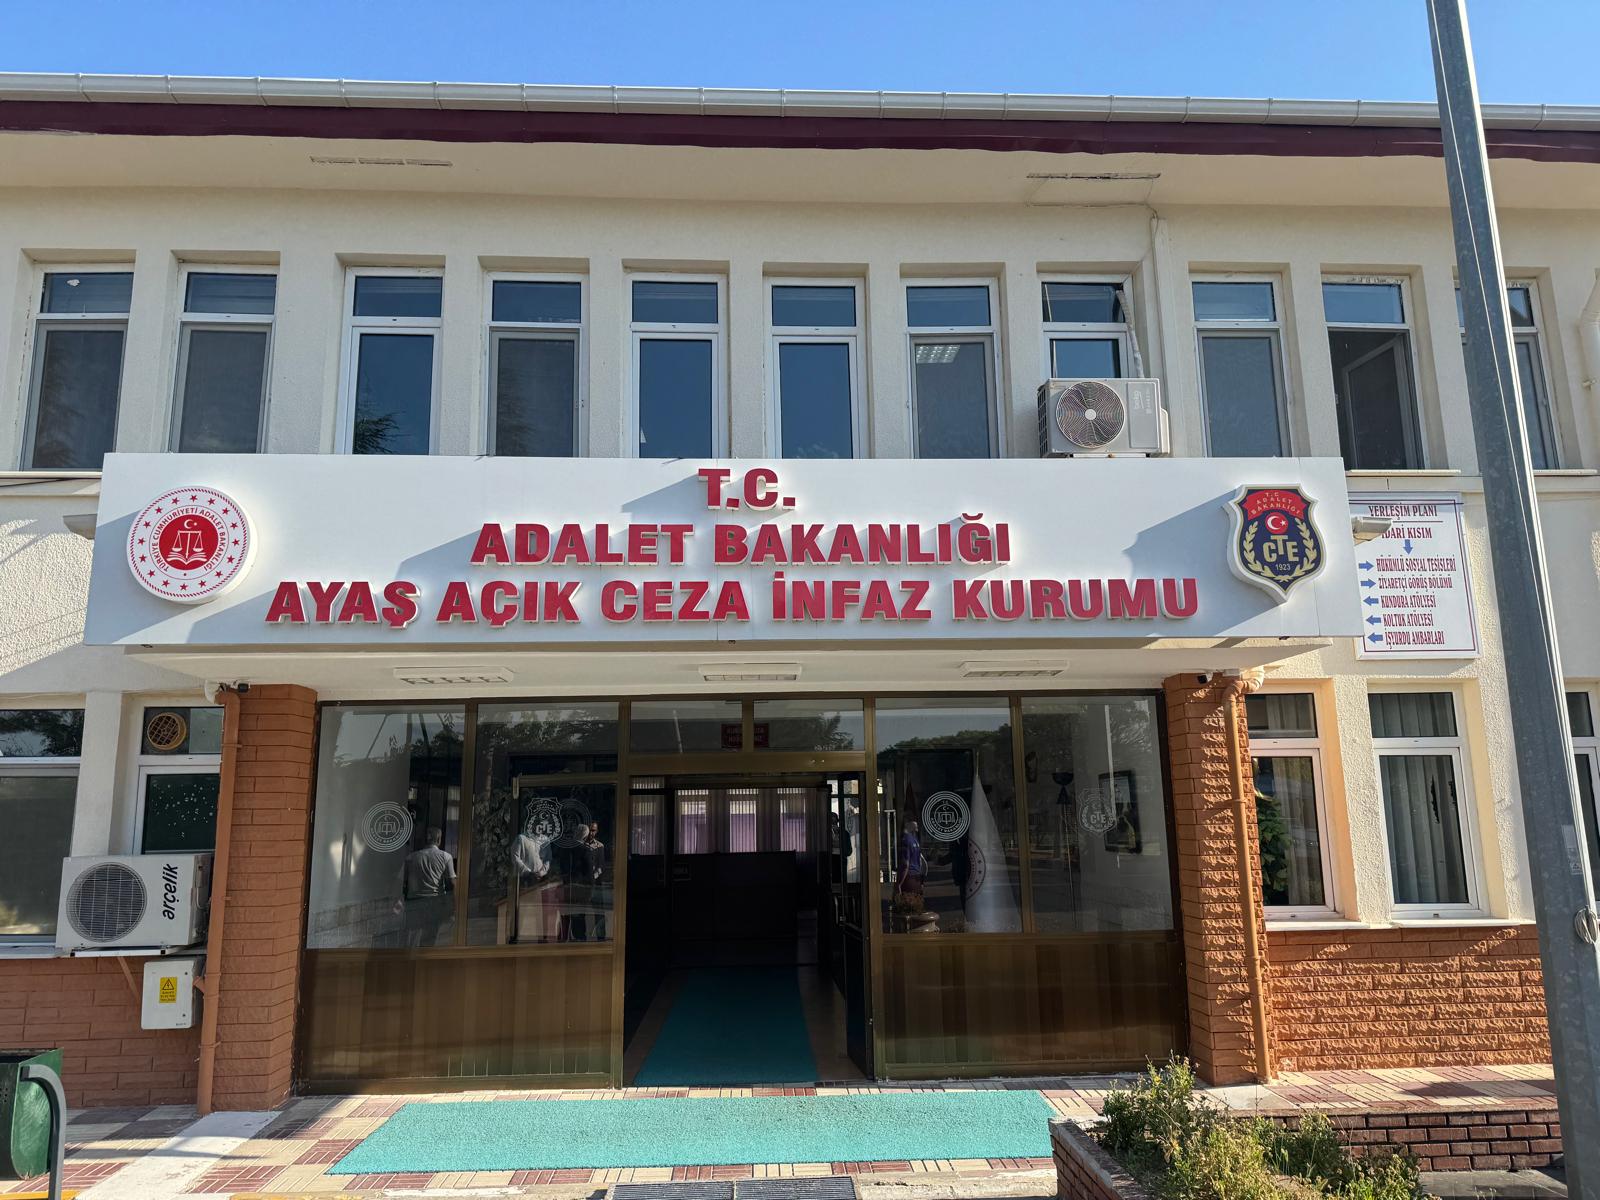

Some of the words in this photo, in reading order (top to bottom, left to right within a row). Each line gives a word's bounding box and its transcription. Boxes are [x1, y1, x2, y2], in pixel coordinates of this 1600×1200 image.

[699, 469, 796, 508] T.C.
[1256, 497, 1293, 505] ADALET
[1368, 503, 1411, 520] YERLEŞİM
[1412, 505, 1438, 517] PLANI
[152, 507, 198, 540] CUMHURİYETİ
[199, 509, 225, 532] ADALET
[470, 524, 694, 564] ADALET
[714, 513, 1011, 564] BAKANLIĞI
[1408, 527, 1433, 539] KISIM
[1262, 535, 1299, 563] CTE
[1275, 563, 1291, 571] 1923
[1376, 554, 1405, 572] HÜKÜMLÜ
[1405, 558, 1427, 572] SOSYAL
[1427, 554, 1457, 572] TESİSLERİ
[1378, 574, 1408, 592] ZİYARETÇİ
[1408, 574, 1428, 592] GÖRÜŞ
[1429, 574, 1453, 589] BÖLÜMÜ
[266, 581, 418, 628] AYAŞ
[436, 581, 581, 628] AÇIK
[601, 581, 750, 621] CEZA
[772, 571, 932, 620] İNFAZ
[953, 579, 1199, 619] KURUMU
[1381, 595, 1409, 608] KUNDURA
[1409, 591, 1437, 608] ATÖLYESİ
[1382, 613, 1407, 627] KOLTUK
[1407, 609, 1434, 627] ATÖLYESİ
[1384, 628, 1411, 649] İŞYURDU
[1412, 631, 1445, 645] AMBARLARI
[535, 820, 553, 834] CTE
[162, 863, 179, 920] arçelik
